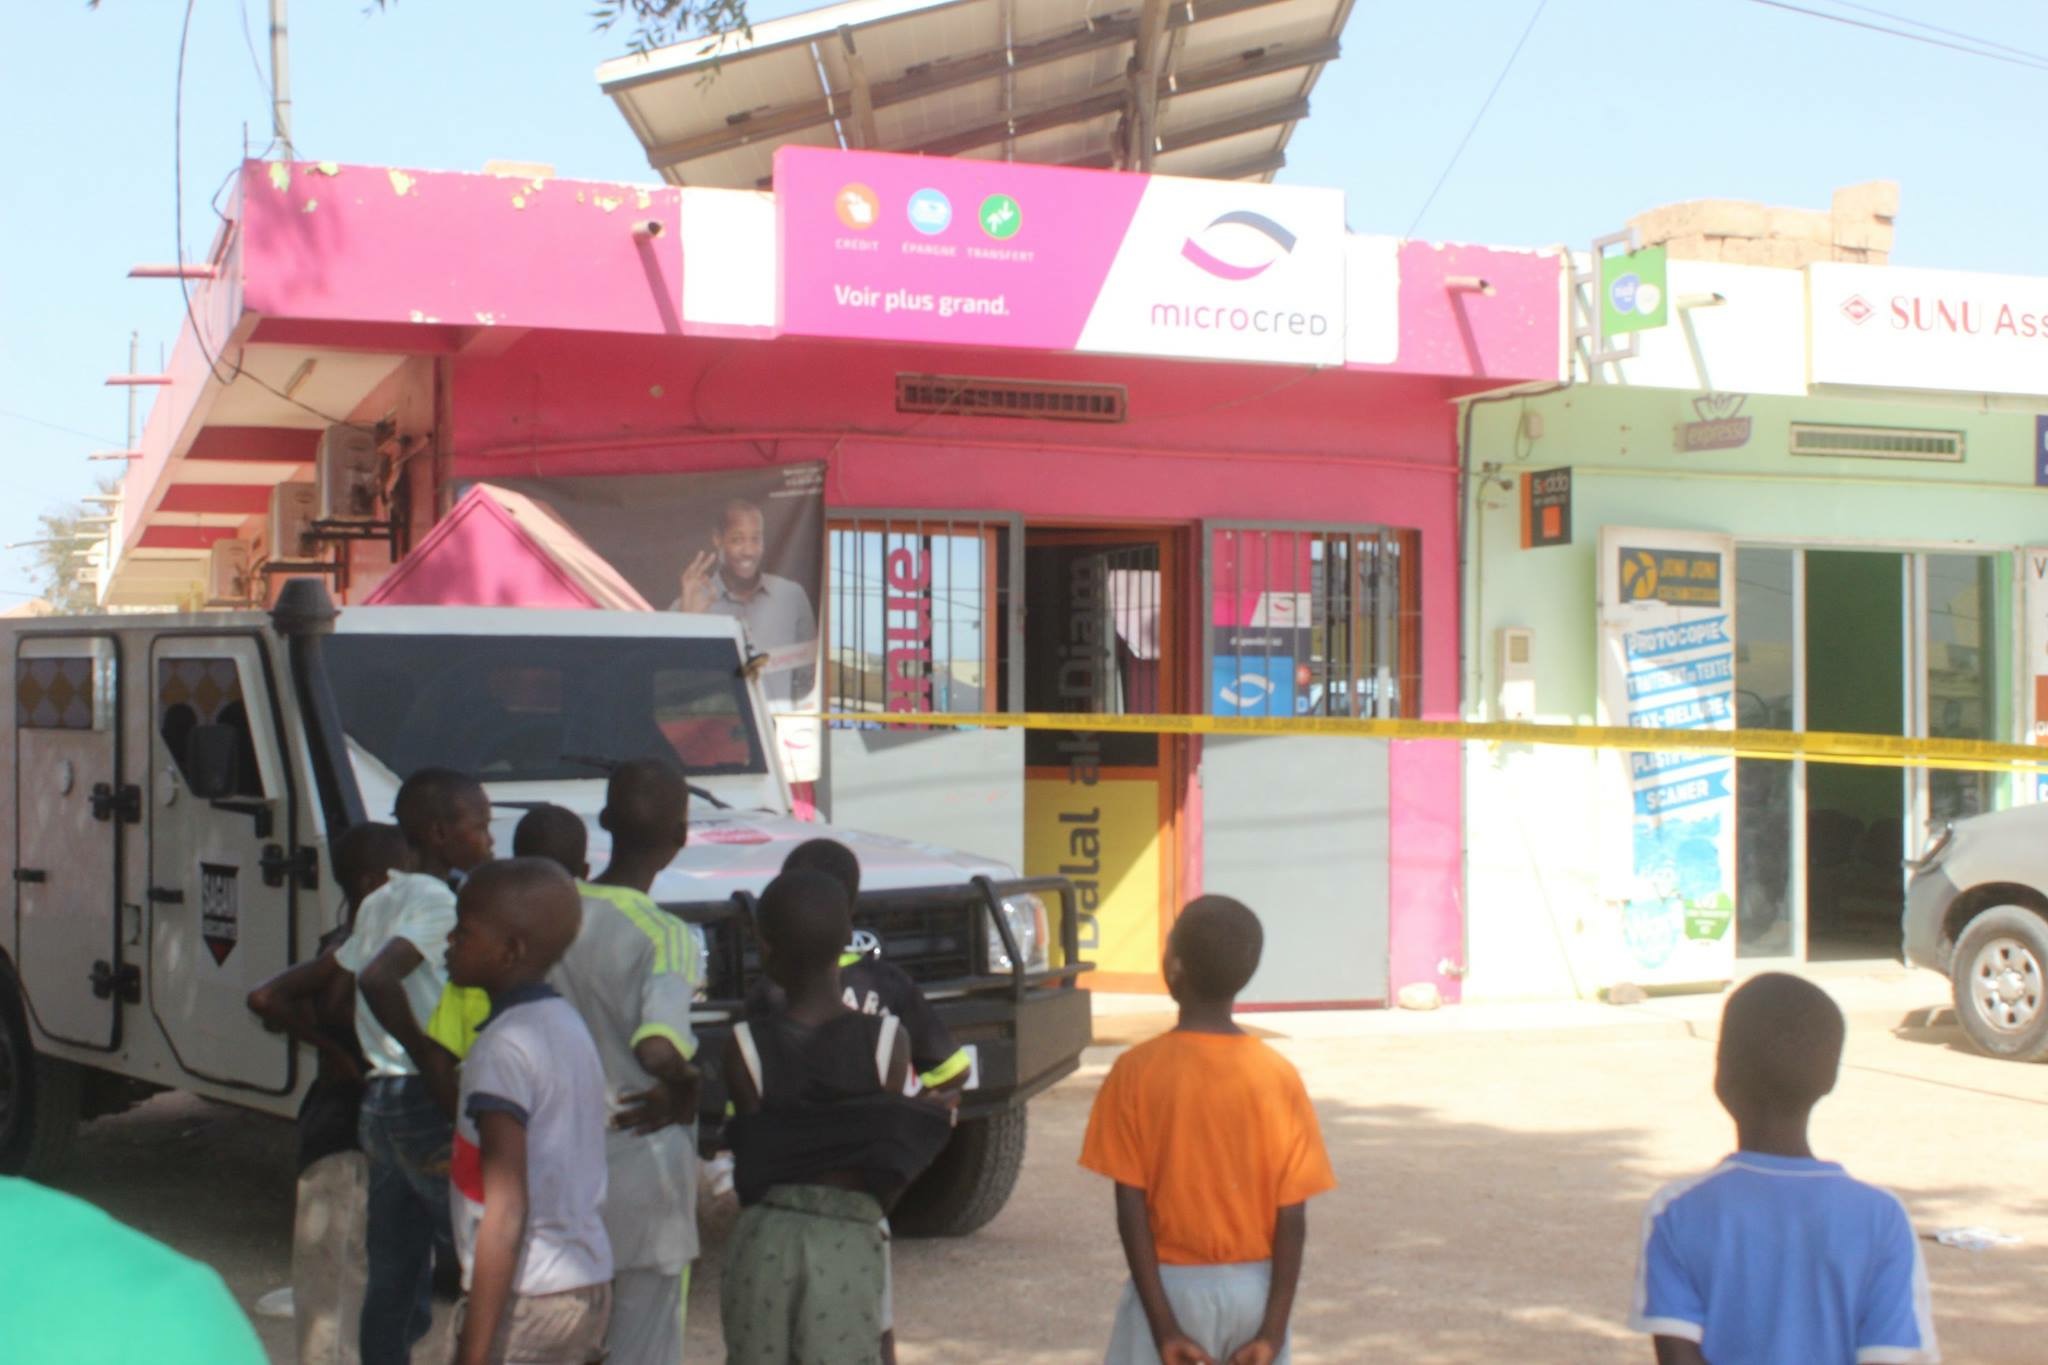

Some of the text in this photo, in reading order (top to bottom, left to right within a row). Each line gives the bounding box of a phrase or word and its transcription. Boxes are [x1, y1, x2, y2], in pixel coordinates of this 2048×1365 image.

[966, 247, 1034, 262] TRANSFERT
[834, 284, 1010, 317] Voir plus grand.
[1890, 295, 1982, 335] SUNU
[1627, 620, 1721, 654] PHOTOCOPIE
[1058, 807, 1099, 949] Dalal
